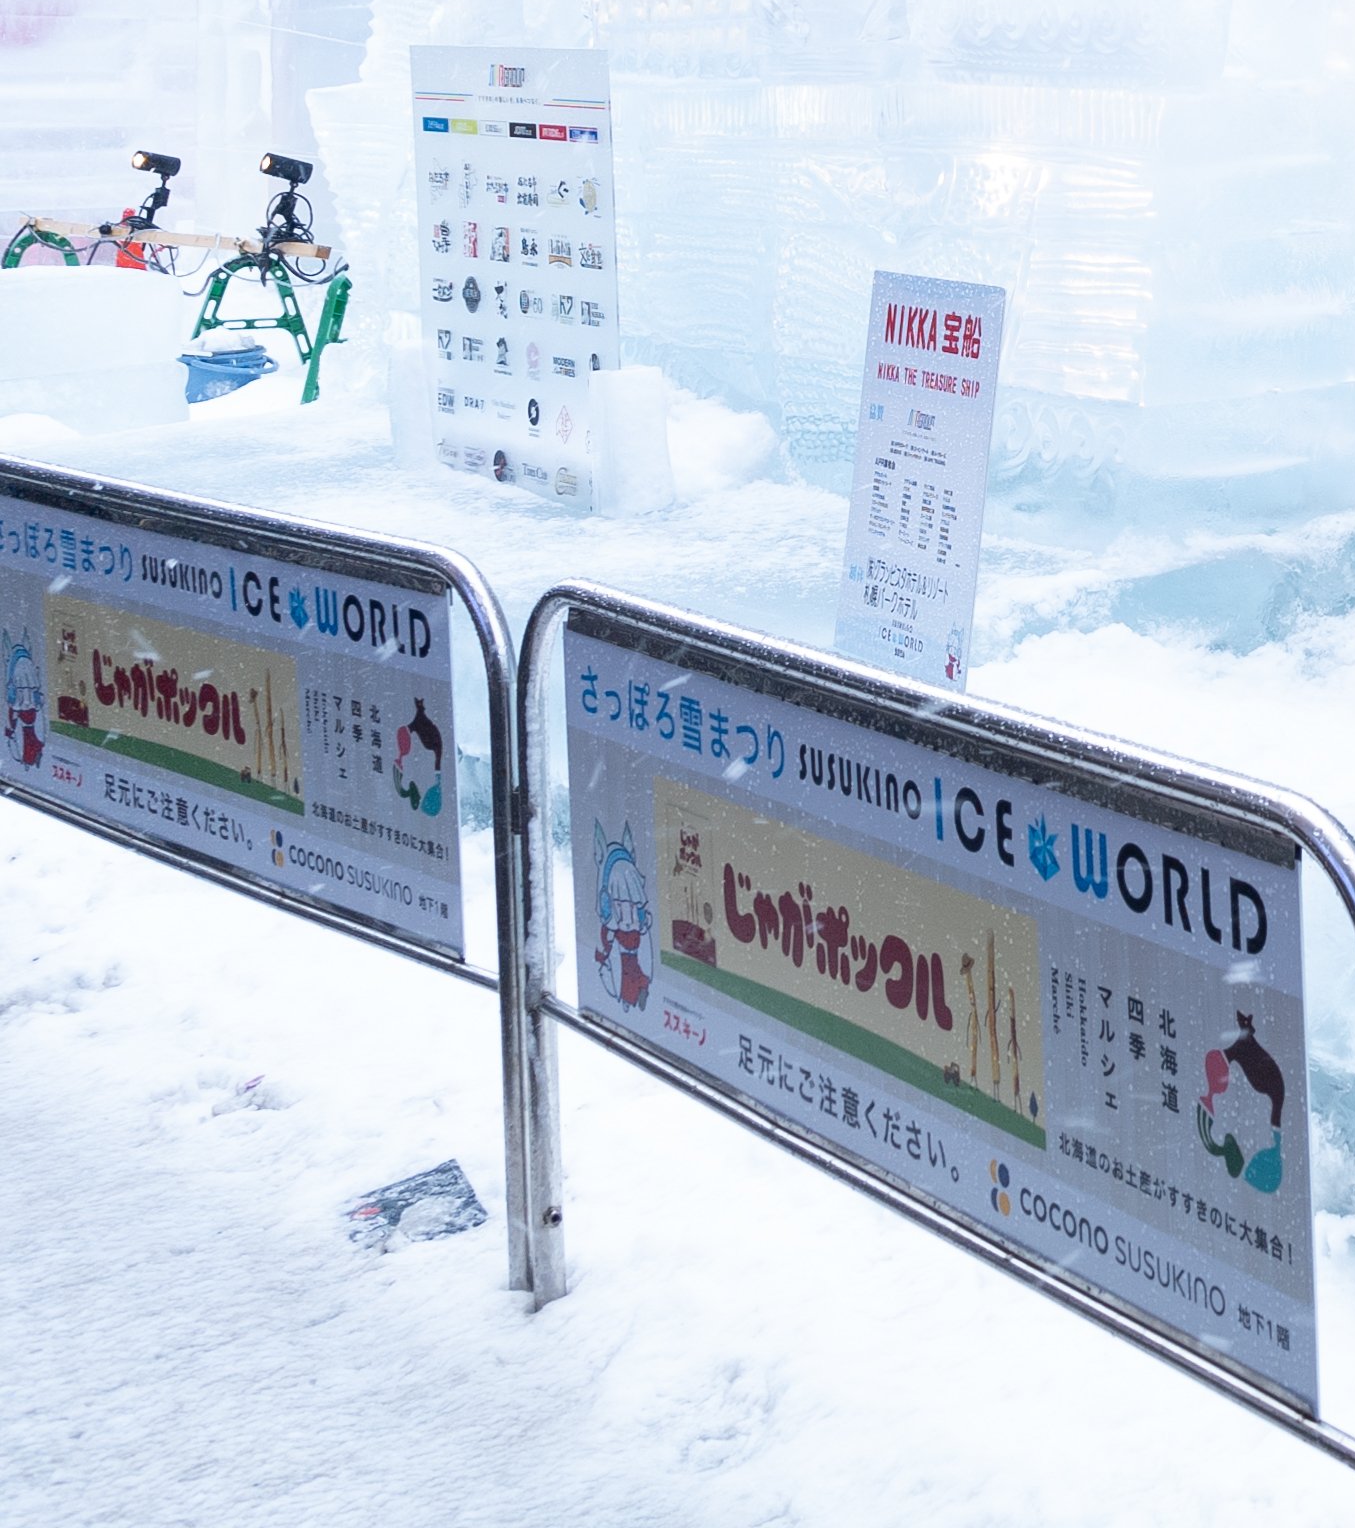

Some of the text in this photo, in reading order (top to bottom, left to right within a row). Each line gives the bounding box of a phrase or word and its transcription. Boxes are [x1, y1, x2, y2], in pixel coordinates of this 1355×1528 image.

[885, 303, 982, 359] NIKKA 宝船
[877, 362, 980, 398] NIKKA THE TREASURE SHIP
[229, 567, 282, 622] ICE
[315, 587, 431, 658] WORLD
[898, 632, 924, 653] WORLD
[93, 649, 246, 745] じゃがポックル
[332, 695, 348, 779] マルシェ
[103, 773, 253, 851] 足元にご注意ください。
[581, 665, 785, 779] さっぽろ雪まつり
[934, 777, 1015, 868] ICE
[1071, 823, 1268, 955] WORLD
[723, 863, 953, 1031] じゃがポックル
[663, 1009, 706, 1046] ススキーノ
[1064, 971, 1074, 1019] Shiki
[1078, 977, 1089, 1067] Hokkaido
[1127, 996, 1146, 1060] 四季
[1097, 985, 1118, 1110] マルシェ
[1158, 1008, 1180, 1113] 北海道
[738, 1033, 960, 1183] 足元にご注意ください。
[1059, 1132, 1293, 1265] 北海道のお土産がすすきのに大集合！
[1238, 1304, 1291, 1352] 地下1階
